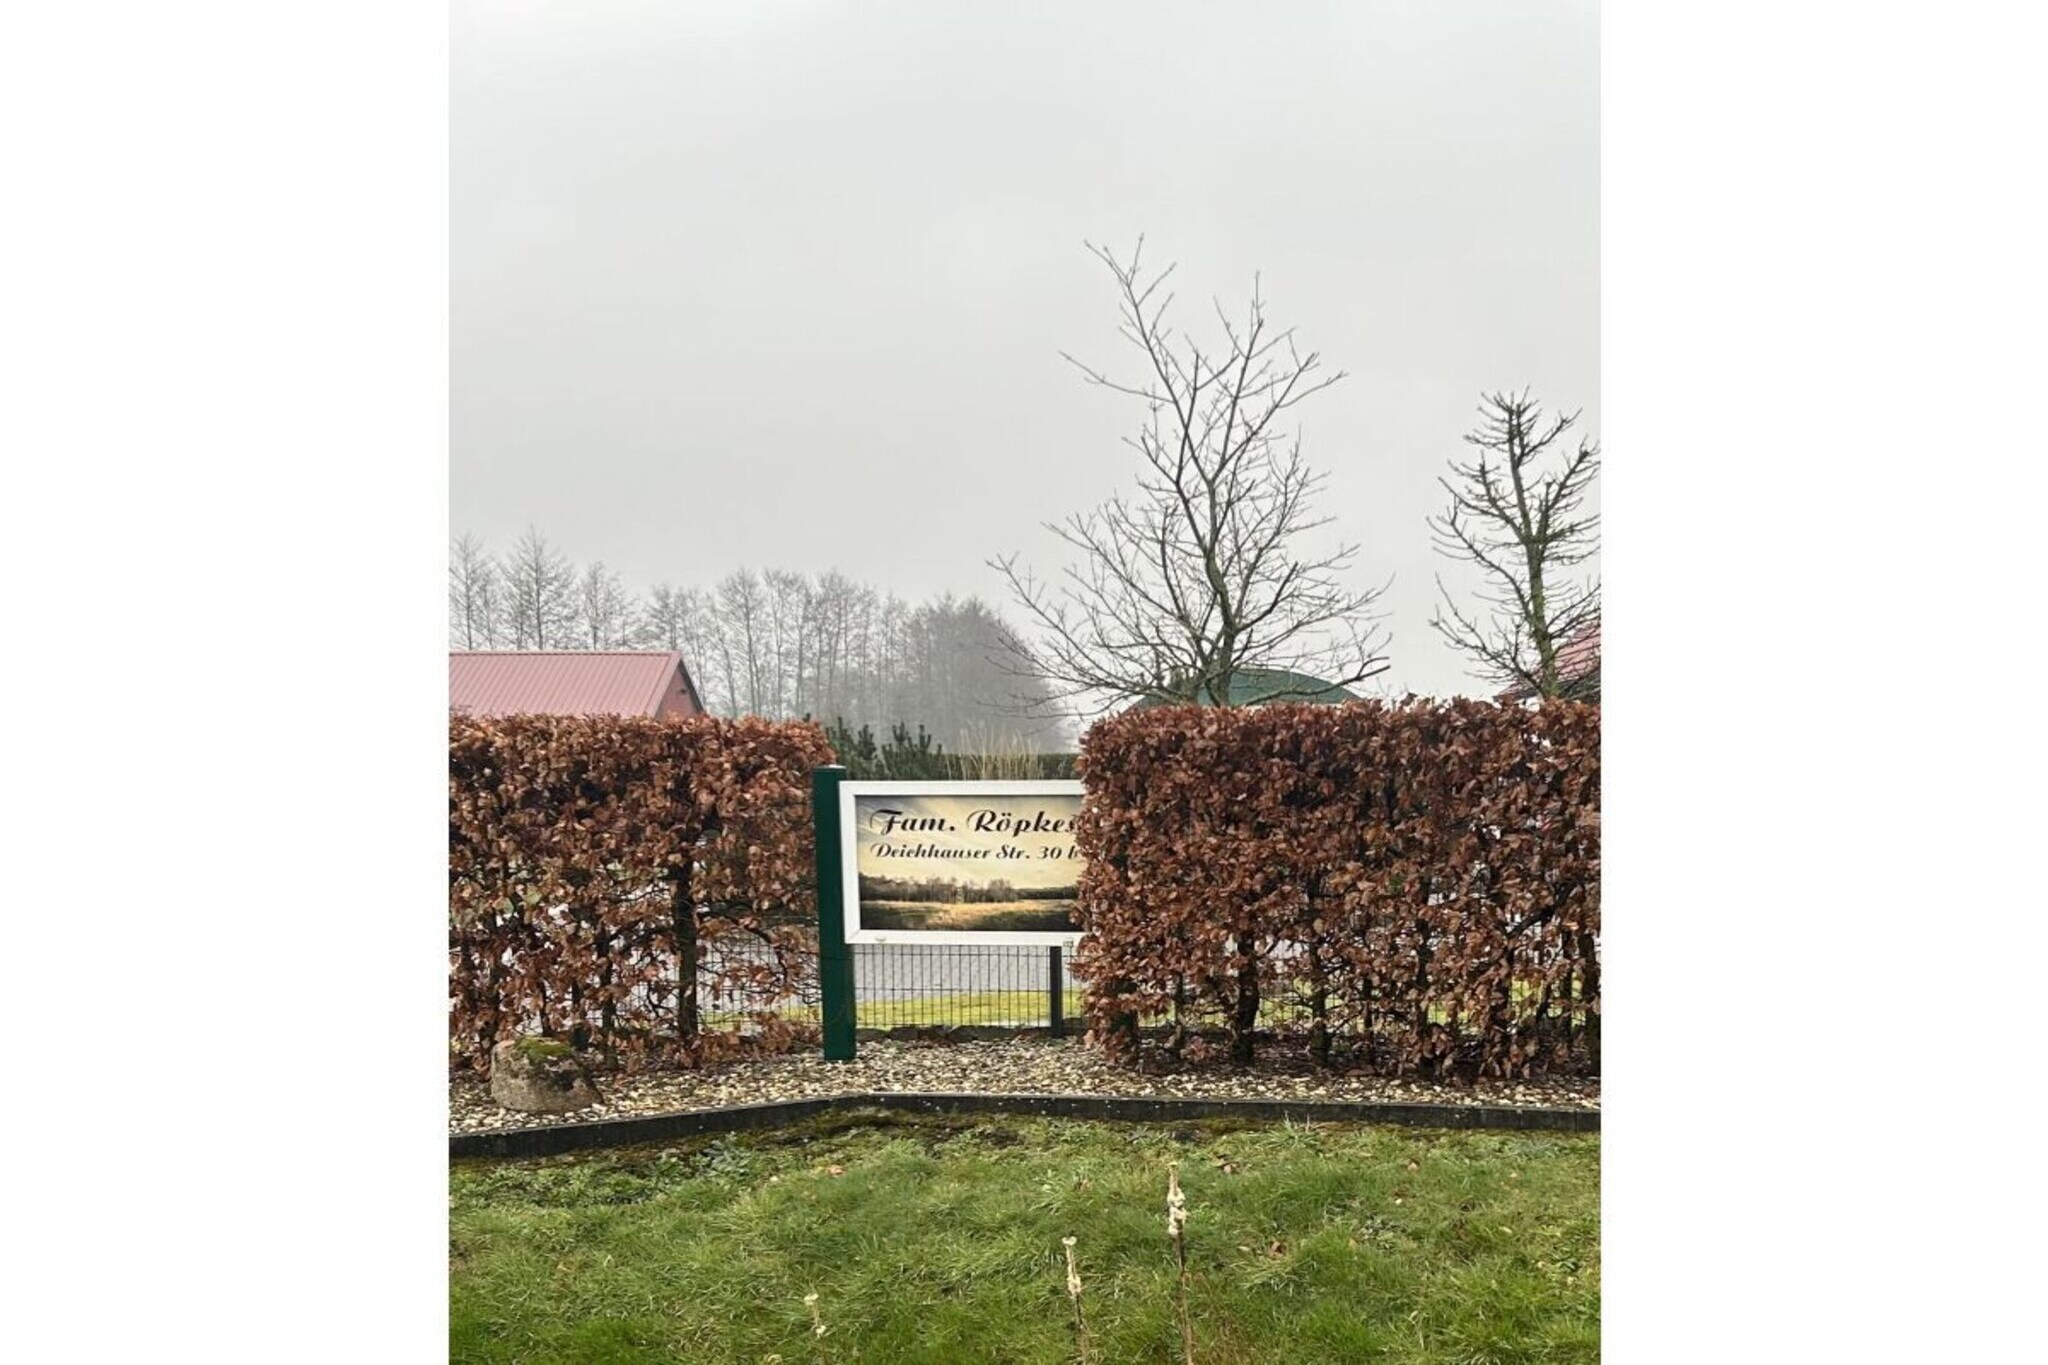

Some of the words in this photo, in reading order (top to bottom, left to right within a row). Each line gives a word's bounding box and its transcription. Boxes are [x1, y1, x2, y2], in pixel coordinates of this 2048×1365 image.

[870, 809, 956, 835] Fam.
[870, 843, 991, 860] Deichhauser
[996, 844, 1030, 860] Str.
[1037, 846, 1062, 860] 30
